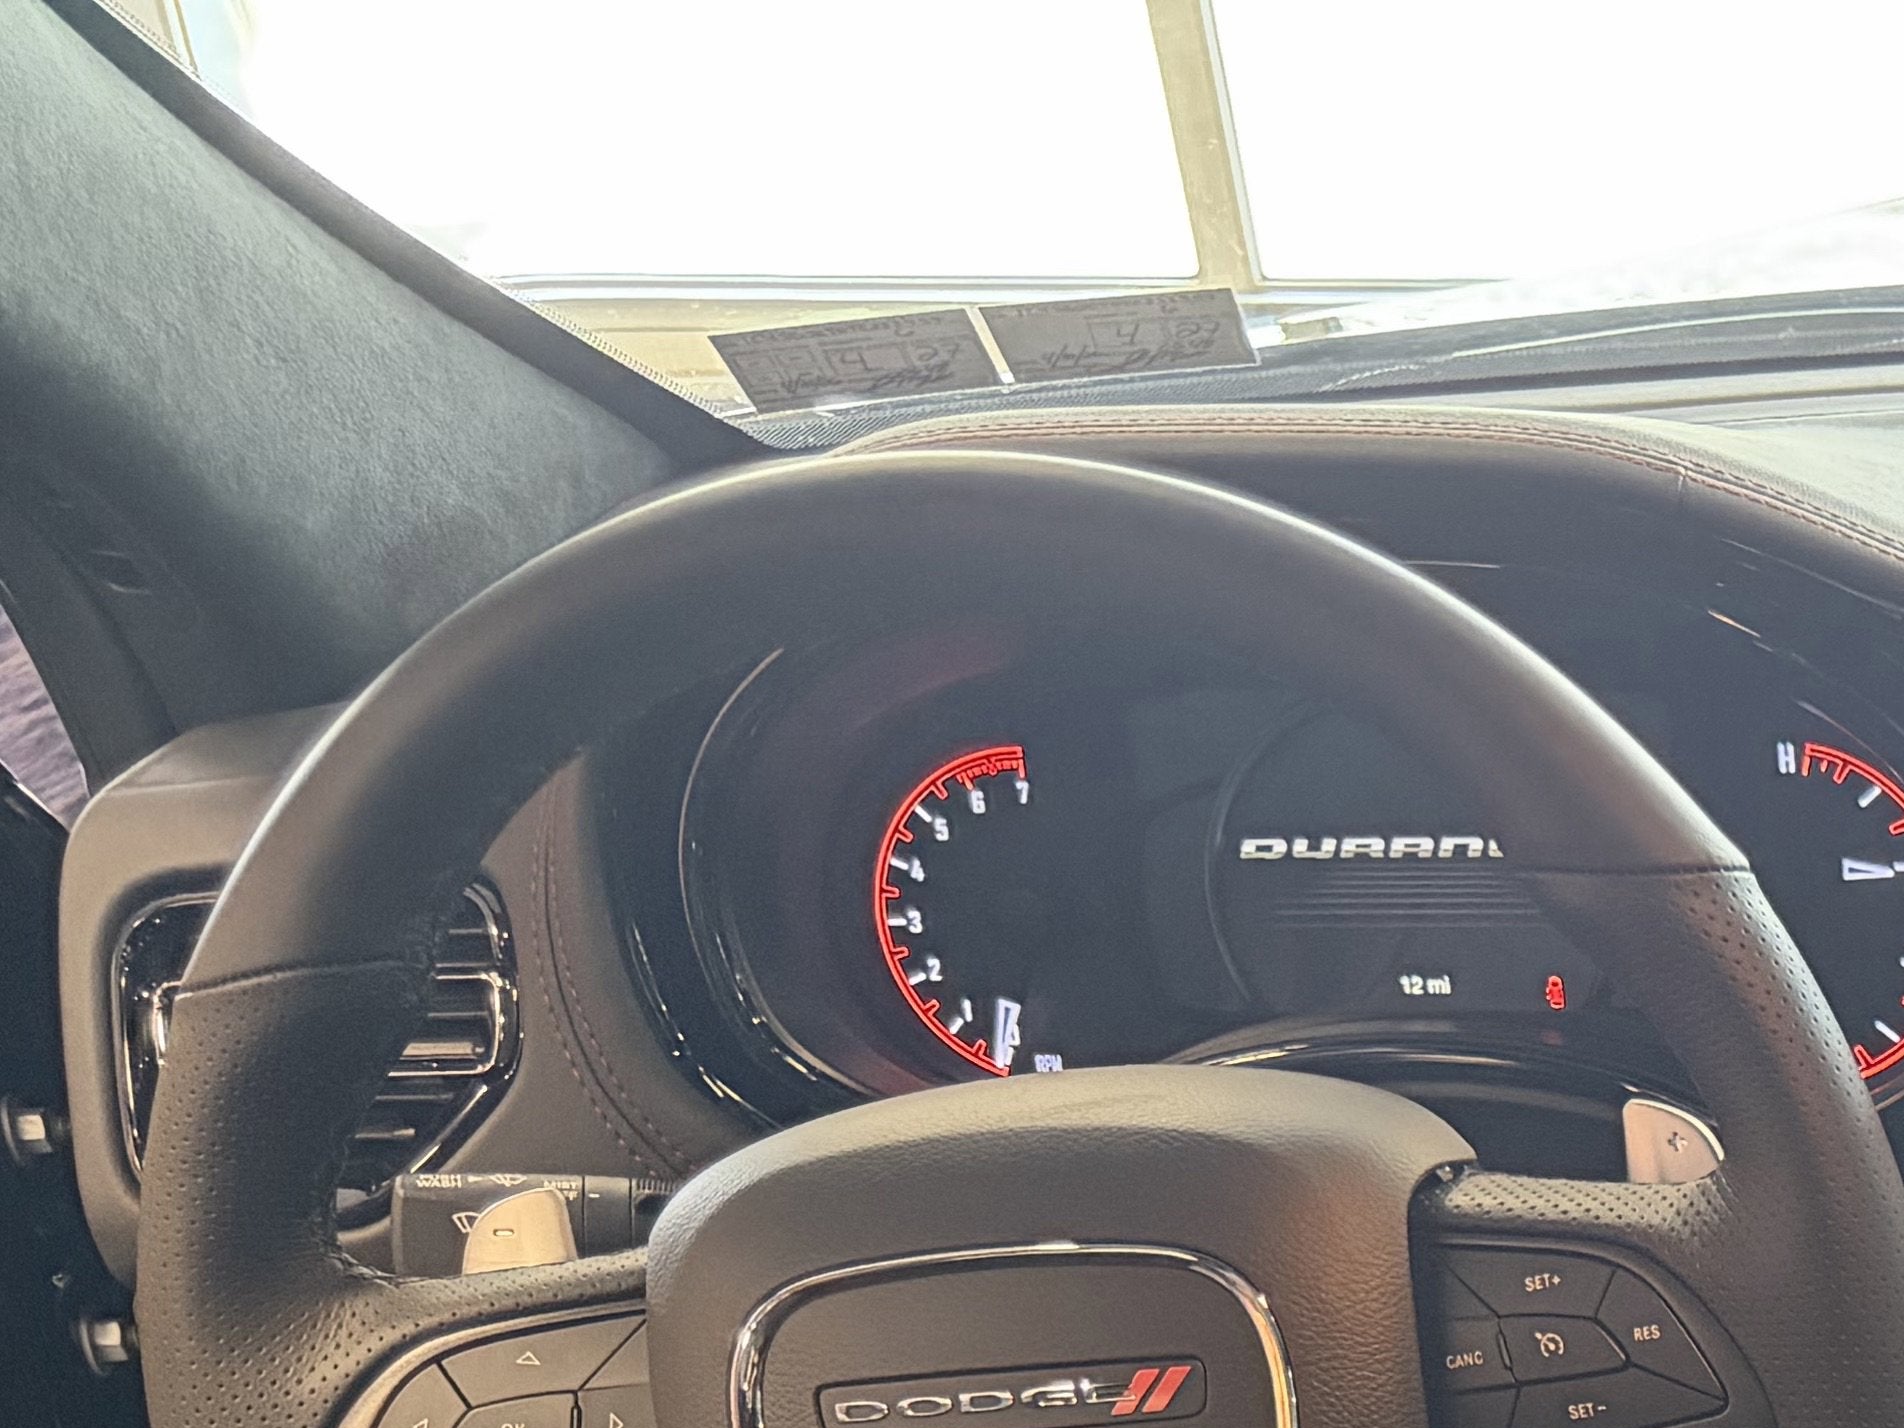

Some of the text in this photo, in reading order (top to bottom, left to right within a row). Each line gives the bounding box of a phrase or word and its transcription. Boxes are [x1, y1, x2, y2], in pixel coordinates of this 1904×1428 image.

[1777, 741, 1796, 774] H
[971, 789, 986, 814] 6
[1015, 780, 1029, 805] 7
[933, 816, 950, 842] 5
[1240, 836, 1504, 860] DURAN
[909, 856, 925, 882] 4
[906, 908, 923, 934] 3
[926, 956, 944, 982] 2
[1427, 974, 1452, 995] mi
[1634, 1324, 1661, 1342] RES
[1446, 1351, 1484, 1369] CANC
[835, 1376, 1138, 1423] DODGE
